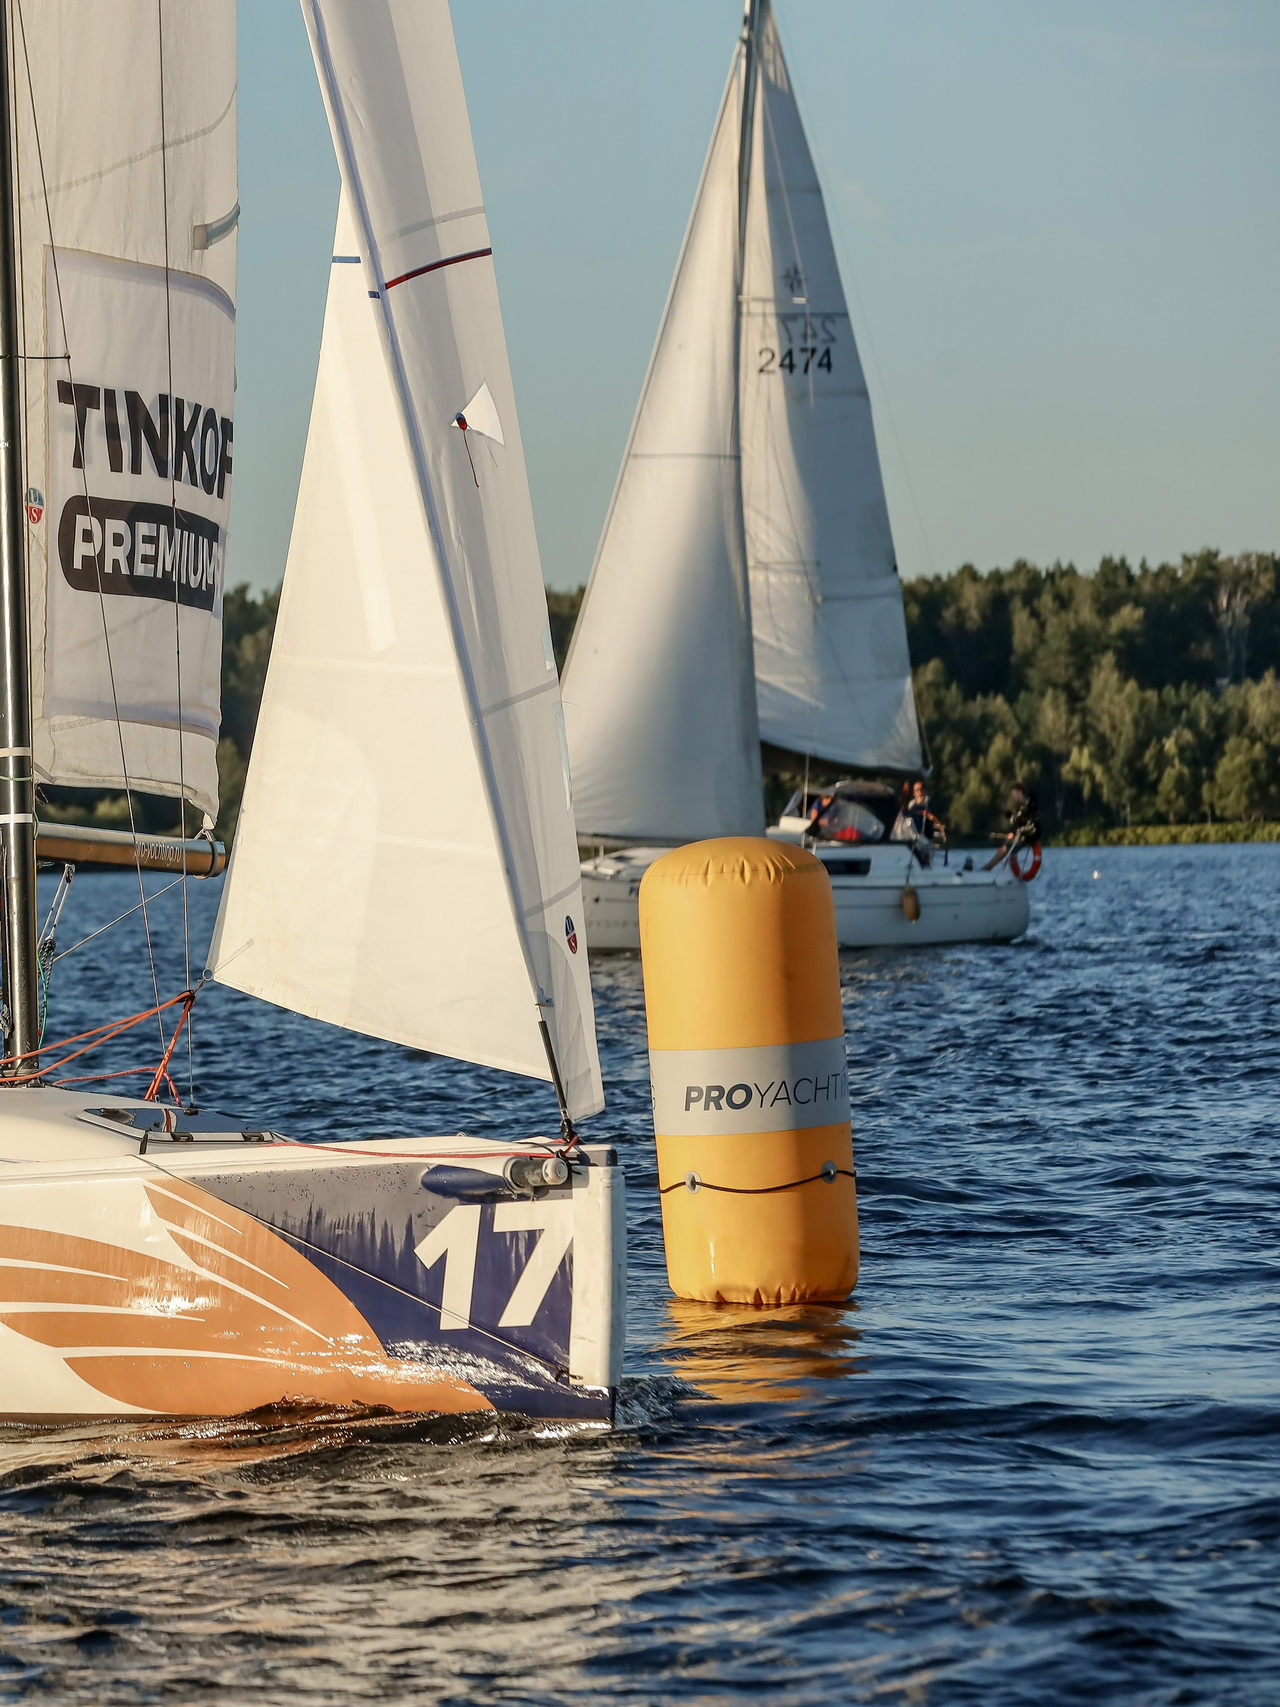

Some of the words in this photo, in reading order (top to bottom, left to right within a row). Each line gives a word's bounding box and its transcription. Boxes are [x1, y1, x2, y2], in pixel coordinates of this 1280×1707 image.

[758, 347, 833, 375] 2474
[57, 380, 234, 500] TINKOF
[73, 514, 219, 592] PREMIUM
[684, 1072, 846, 1112] PROYACHTI
[414, 1199, 574, 1330] 17
